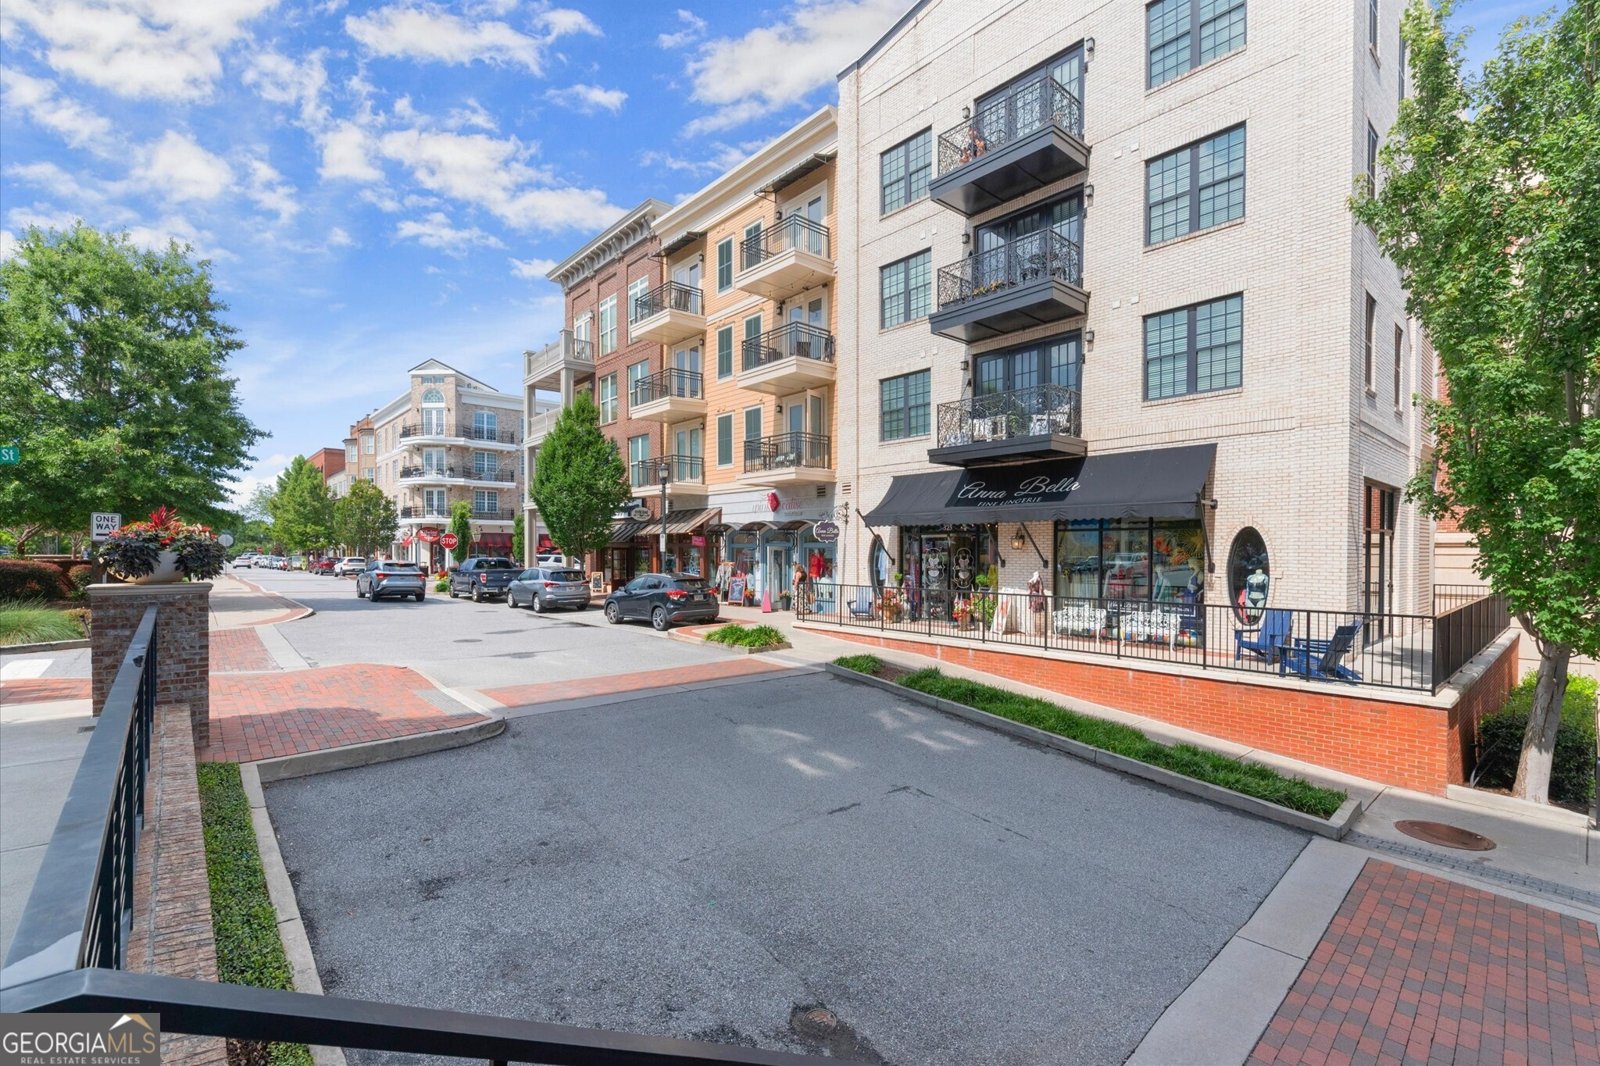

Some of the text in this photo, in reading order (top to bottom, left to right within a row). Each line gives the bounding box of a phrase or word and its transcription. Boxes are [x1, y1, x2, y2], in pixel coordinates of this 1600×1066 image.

[1, 448, 14, 461] St
[957, 475, 1081, 499] Anna Bella
[95, 515, 117, 523] ONE
